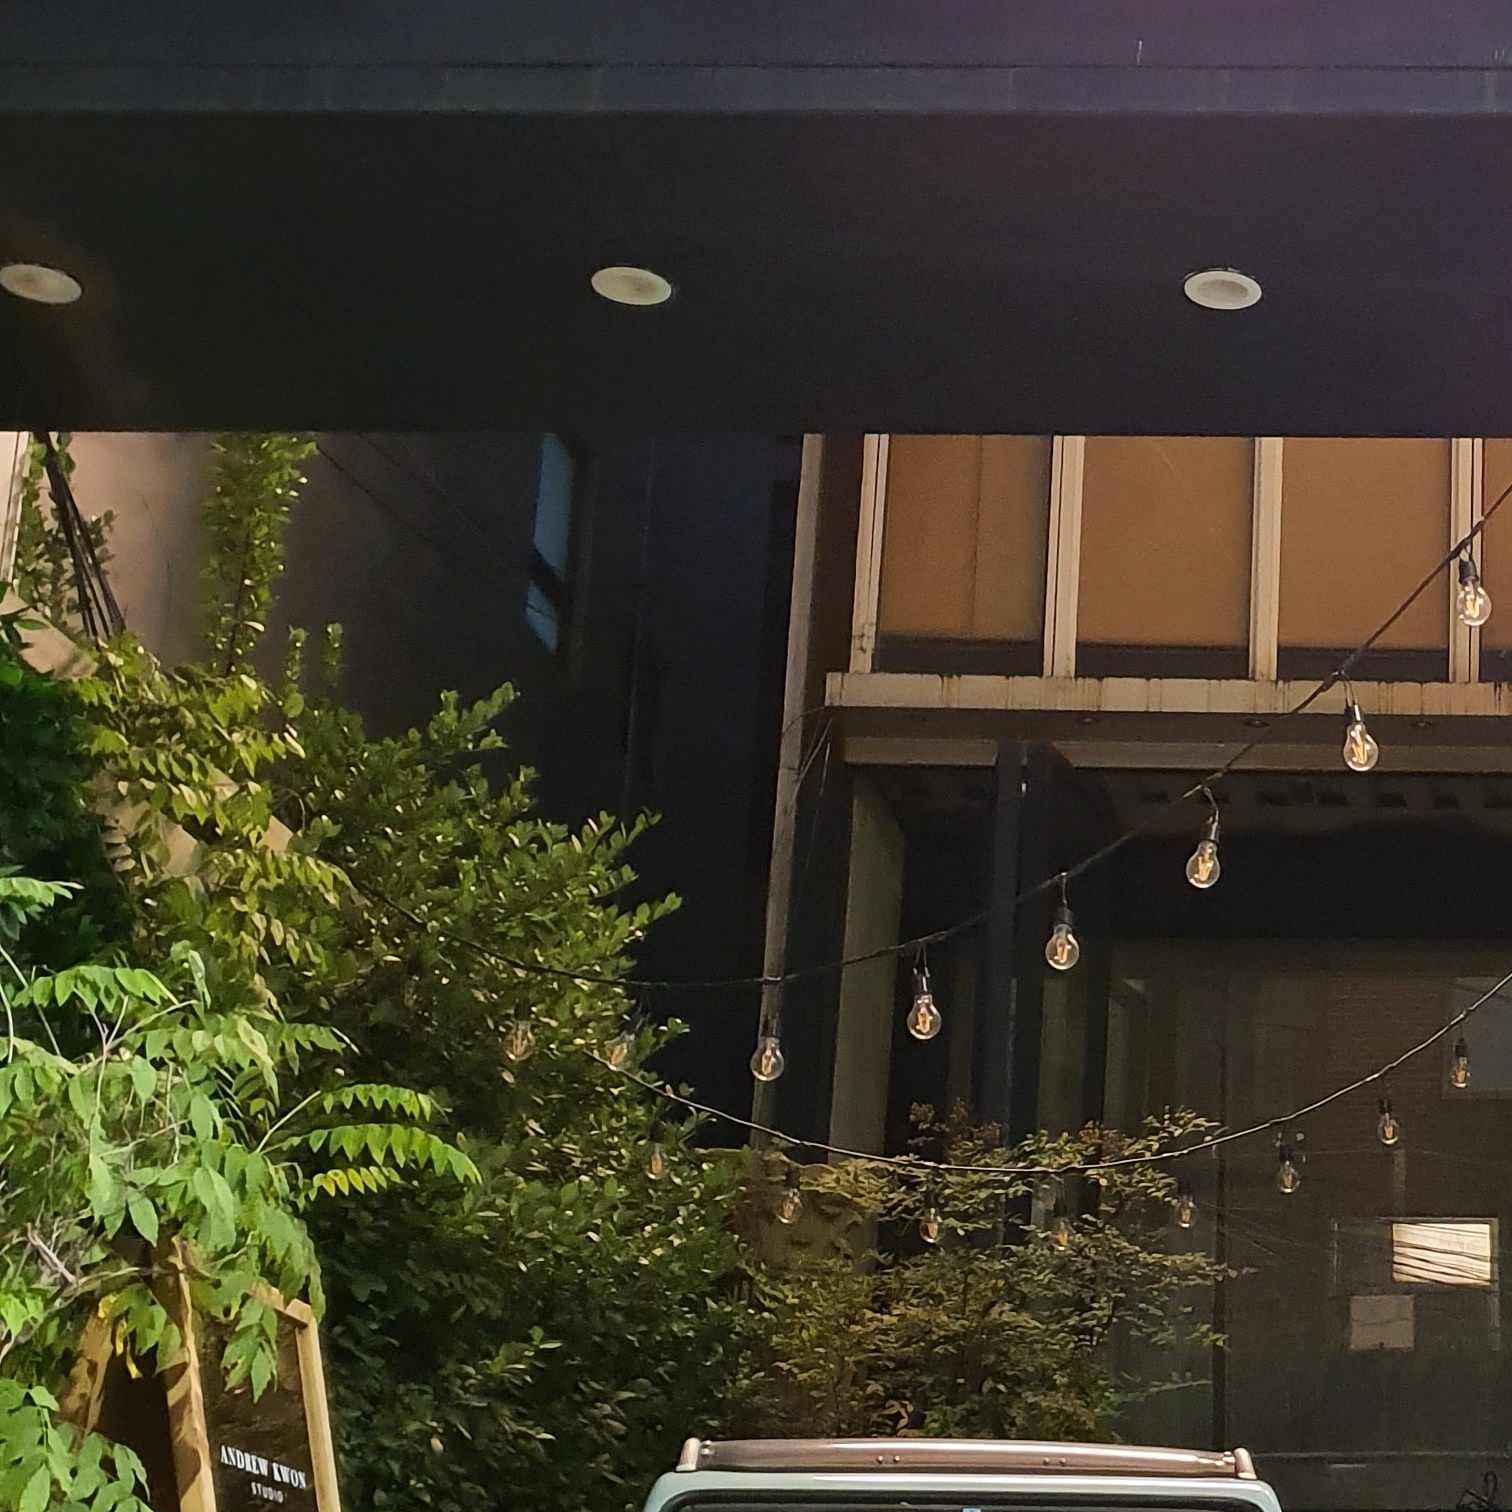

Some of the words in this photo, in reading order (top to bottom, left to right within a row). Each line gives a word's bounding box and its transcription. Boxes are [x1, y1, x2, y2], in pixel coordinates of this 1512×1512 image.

[221, 1445, 268, 1476] ANDREW
[272, 1462, 306, 1489] KWON
[251, 1481, 283, 1503] STUDIO
